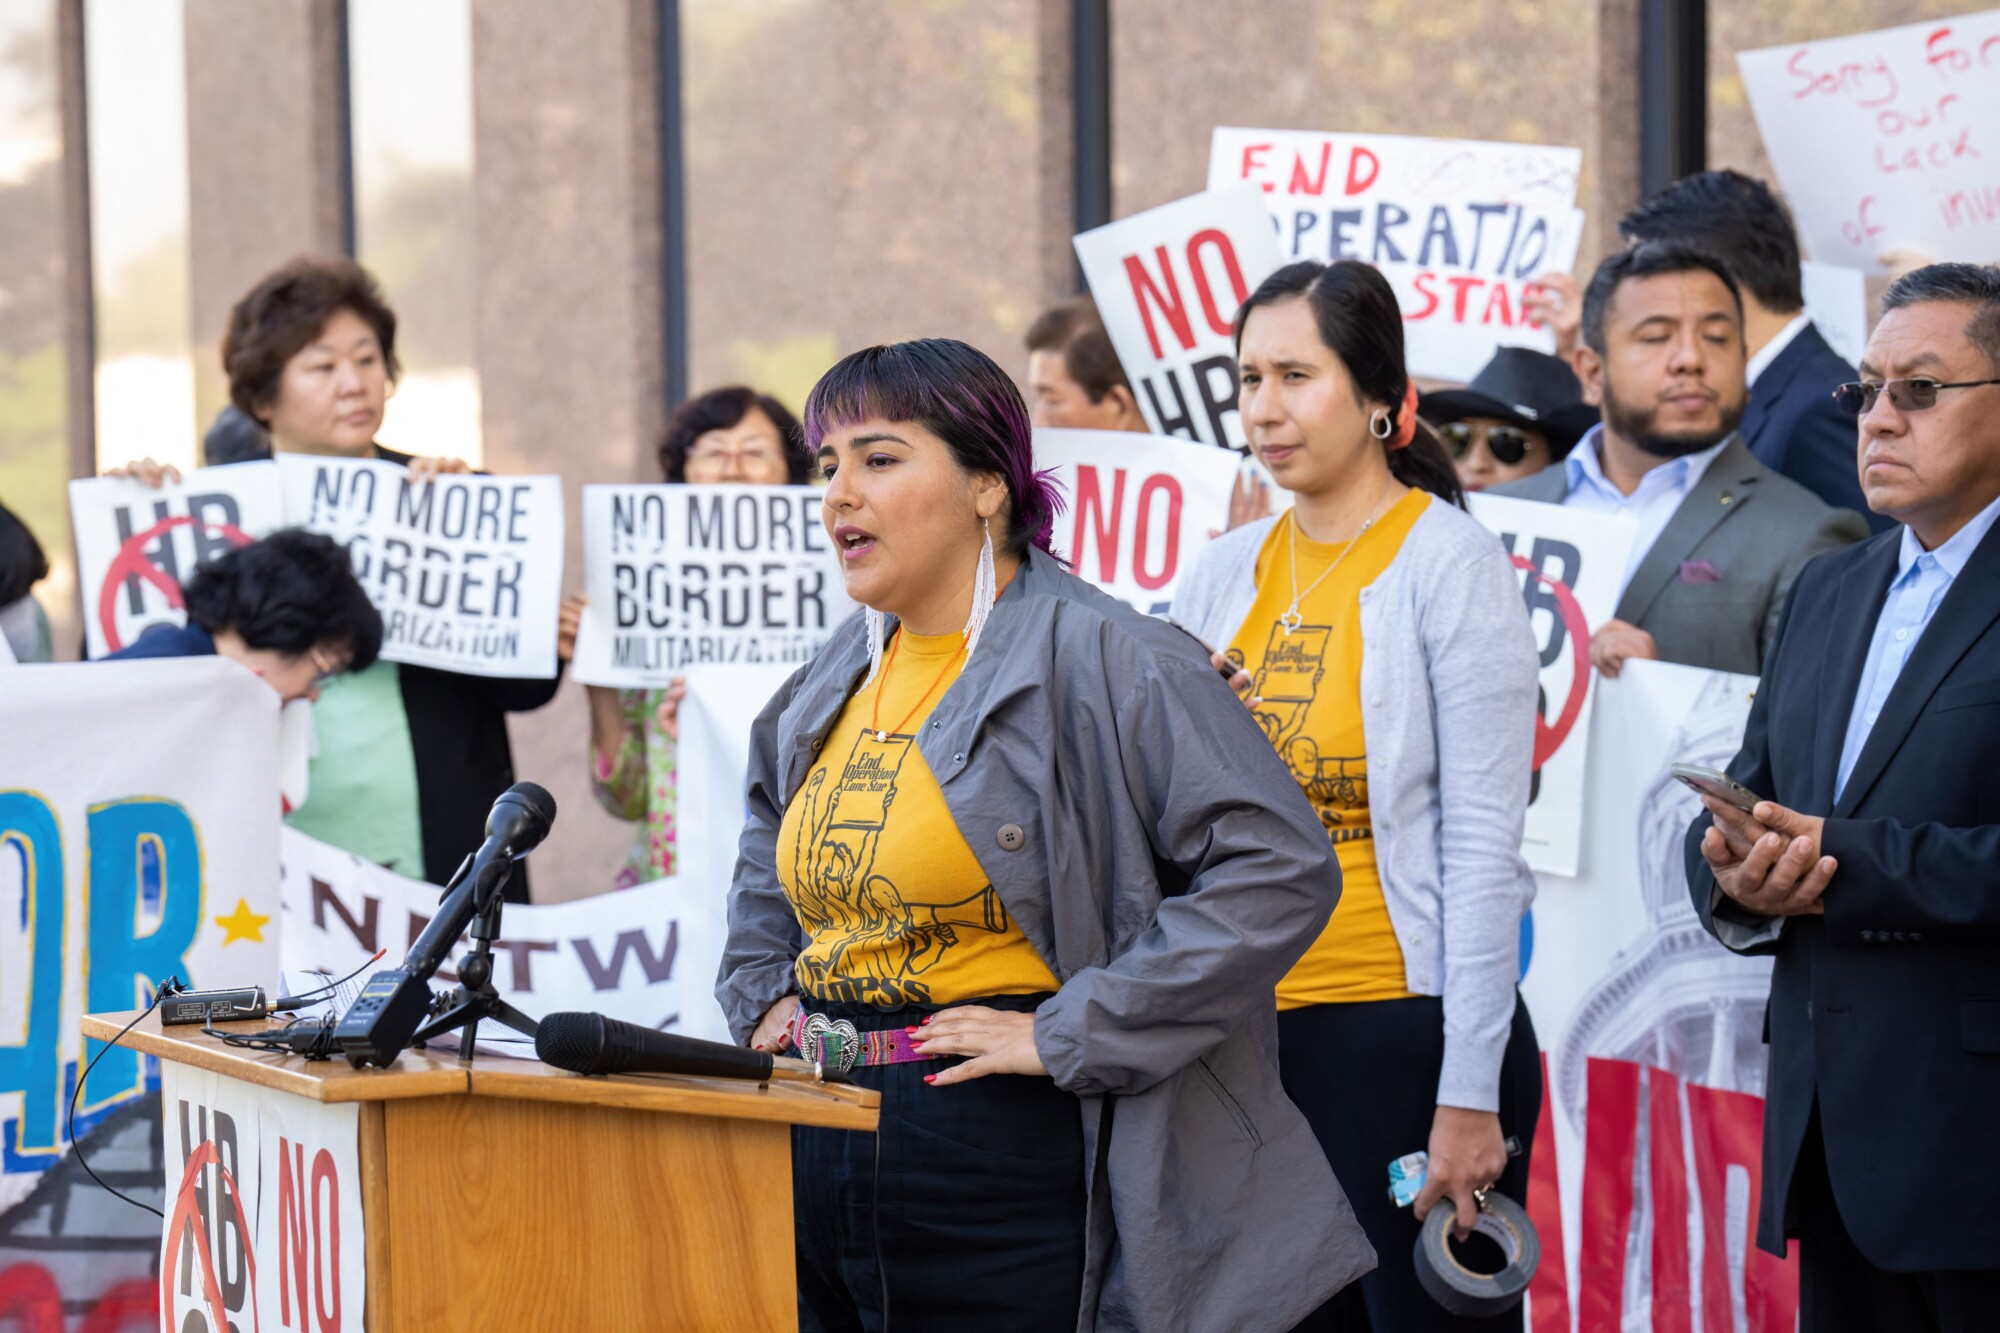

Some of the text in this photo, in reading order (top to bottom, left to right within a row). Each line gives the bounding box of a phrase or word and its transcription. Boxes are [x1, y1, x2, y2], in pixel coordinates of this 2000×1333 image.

[1241, 142, 1380, 196] END
[1267, 200, 1548, 280] PERATIO
[1122, 227, 1249, 361] NO
[310, 466, 532, 543] NO MORE
[612, 493, 826, 554] NO MORE
[1071, 464, 1184, 591] NO
[350, 534, 523, 618] ORDER
[613, 561, 827, 631] BORDER
[843, 779, 887, 792] Lone Star
[844, 764, 895, 782] Operation
[856, 751, 885, 770] End
[279, 1135, 342, 1333] NO
